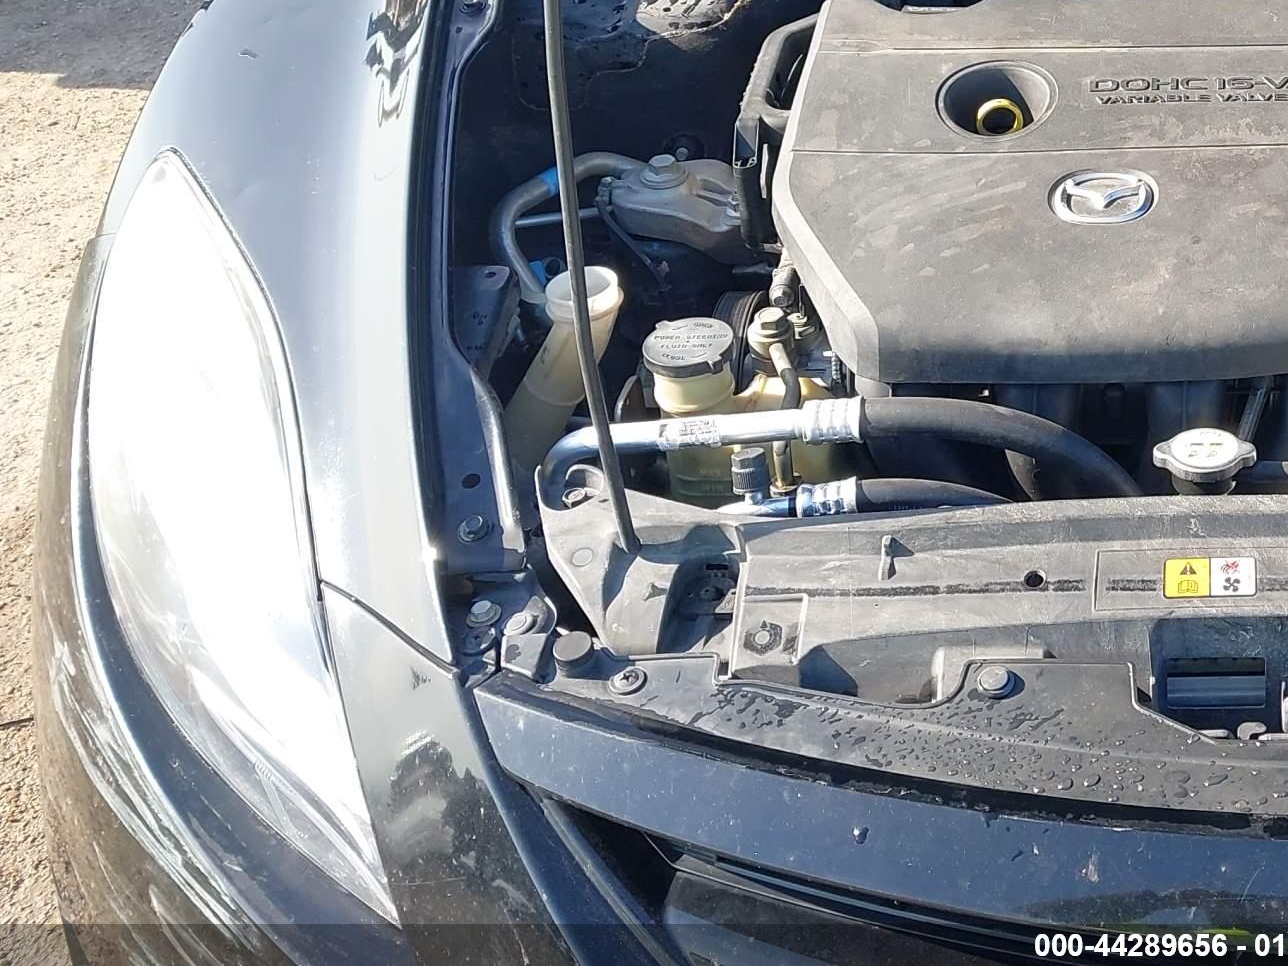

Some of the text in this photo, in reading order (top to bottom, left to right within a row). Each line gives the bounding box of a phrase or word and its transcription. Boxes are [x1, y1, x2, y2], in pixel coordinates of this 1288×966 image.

[1089, 77, 1209, 92] DOHC
[1097, 93, 1212, 105] VARIABLE
[1216, 93, 1288, 102] VALVE
